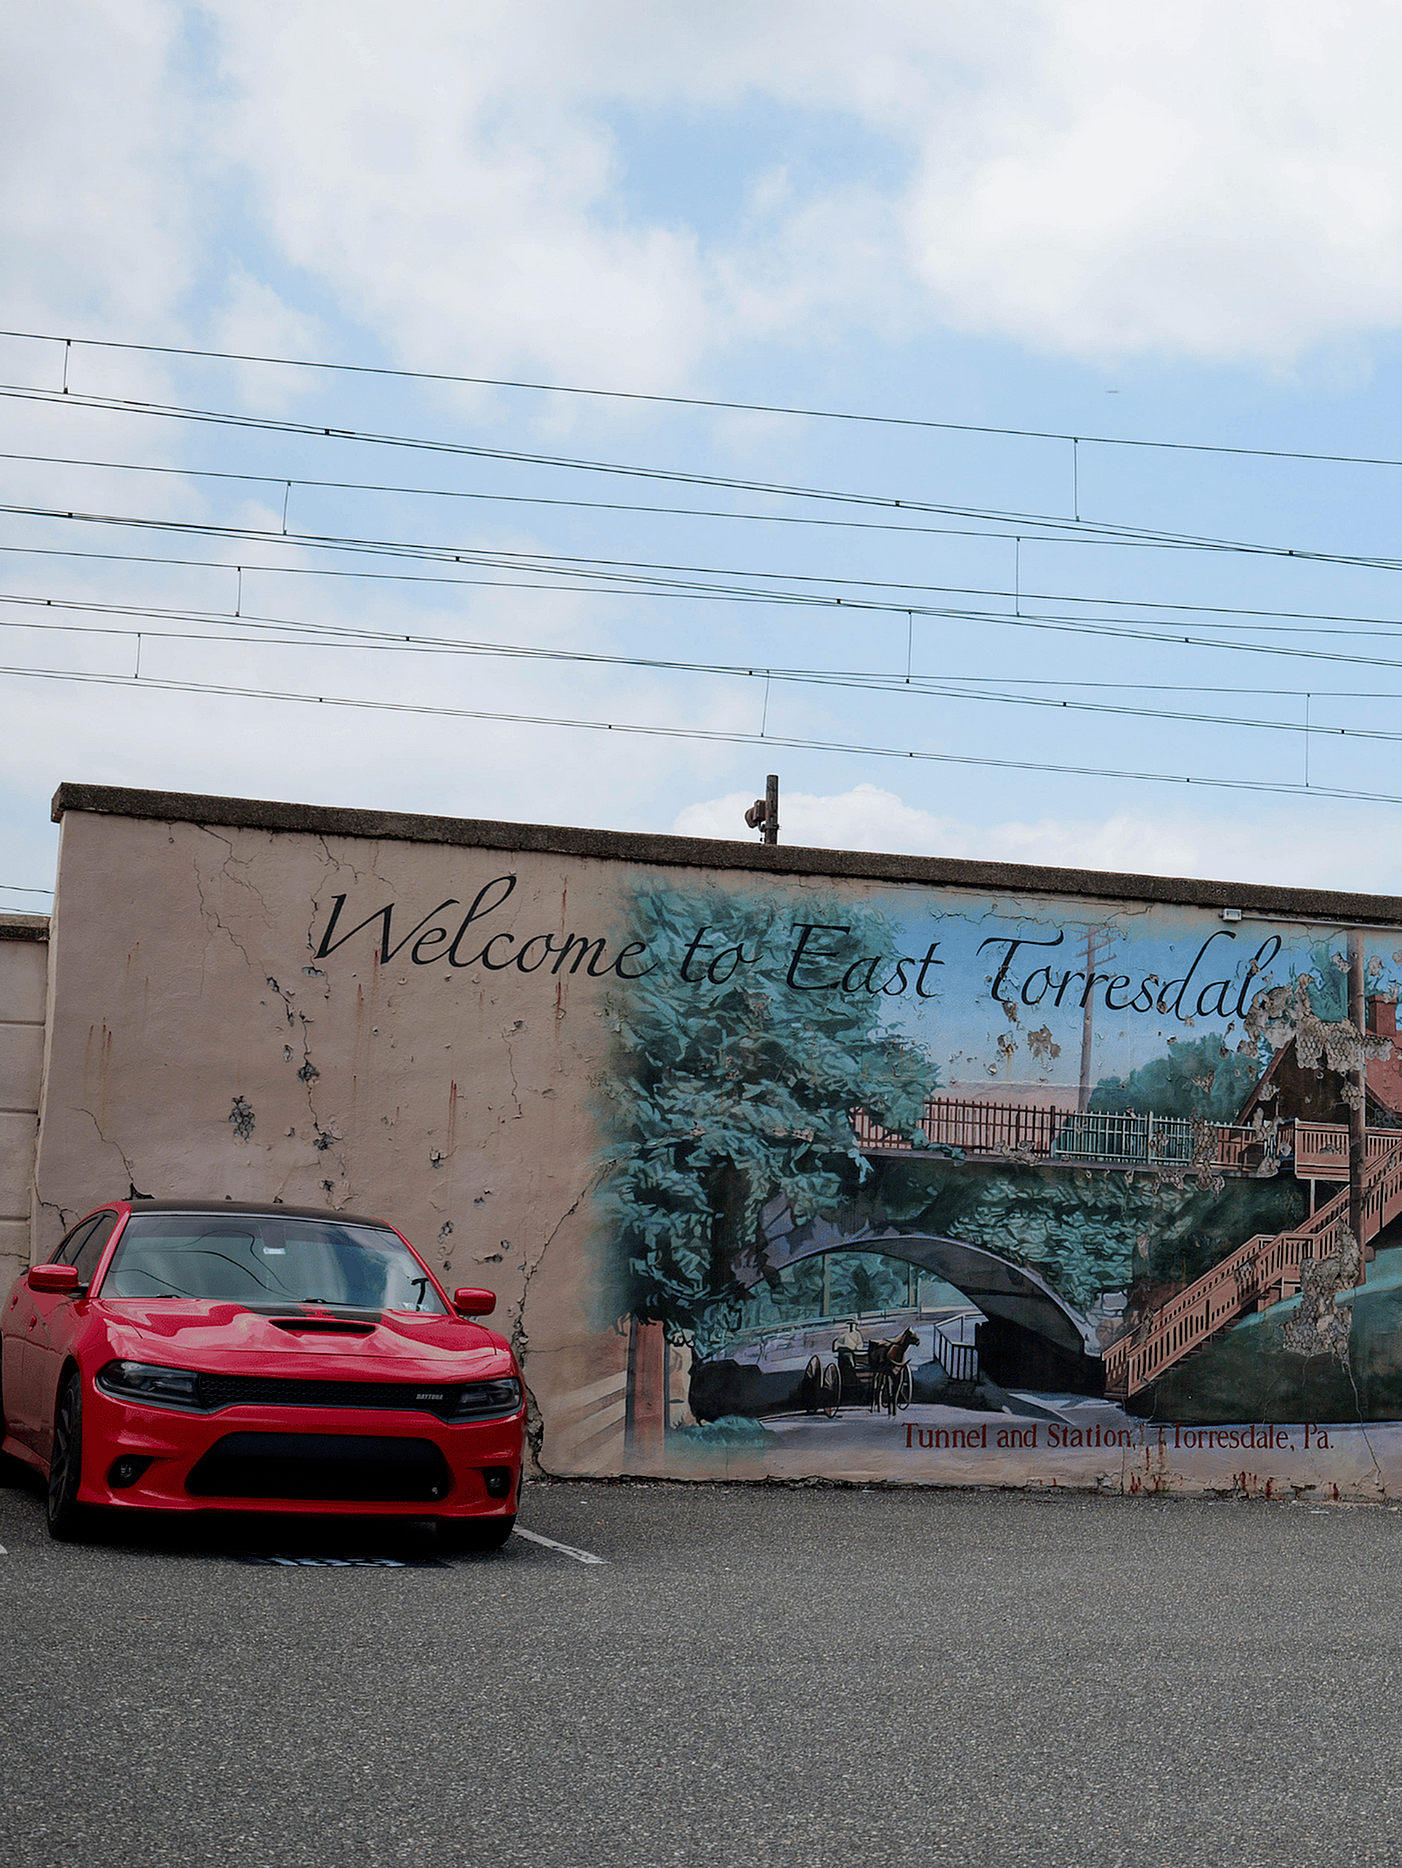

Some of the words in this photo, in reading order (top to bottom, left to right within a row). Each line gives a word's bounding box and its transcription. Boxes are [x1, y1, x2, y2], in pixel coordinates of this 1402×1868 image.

[315, 875, 660, 979] Welcome
[680, 924, 764, 985] to
[787, 922, 946, 999] East
[977, 930, 1285, 1021] Torresdal
[901, 1422, 987, 1448] Tunnel
[997, 1423, 1037, 1448] and
[1047, 1423, 1137, 1451] Station,
[1172, 1423, 1295, 1452] Torresdale,
[1303, 1423, 1335, 1449] Pa.
